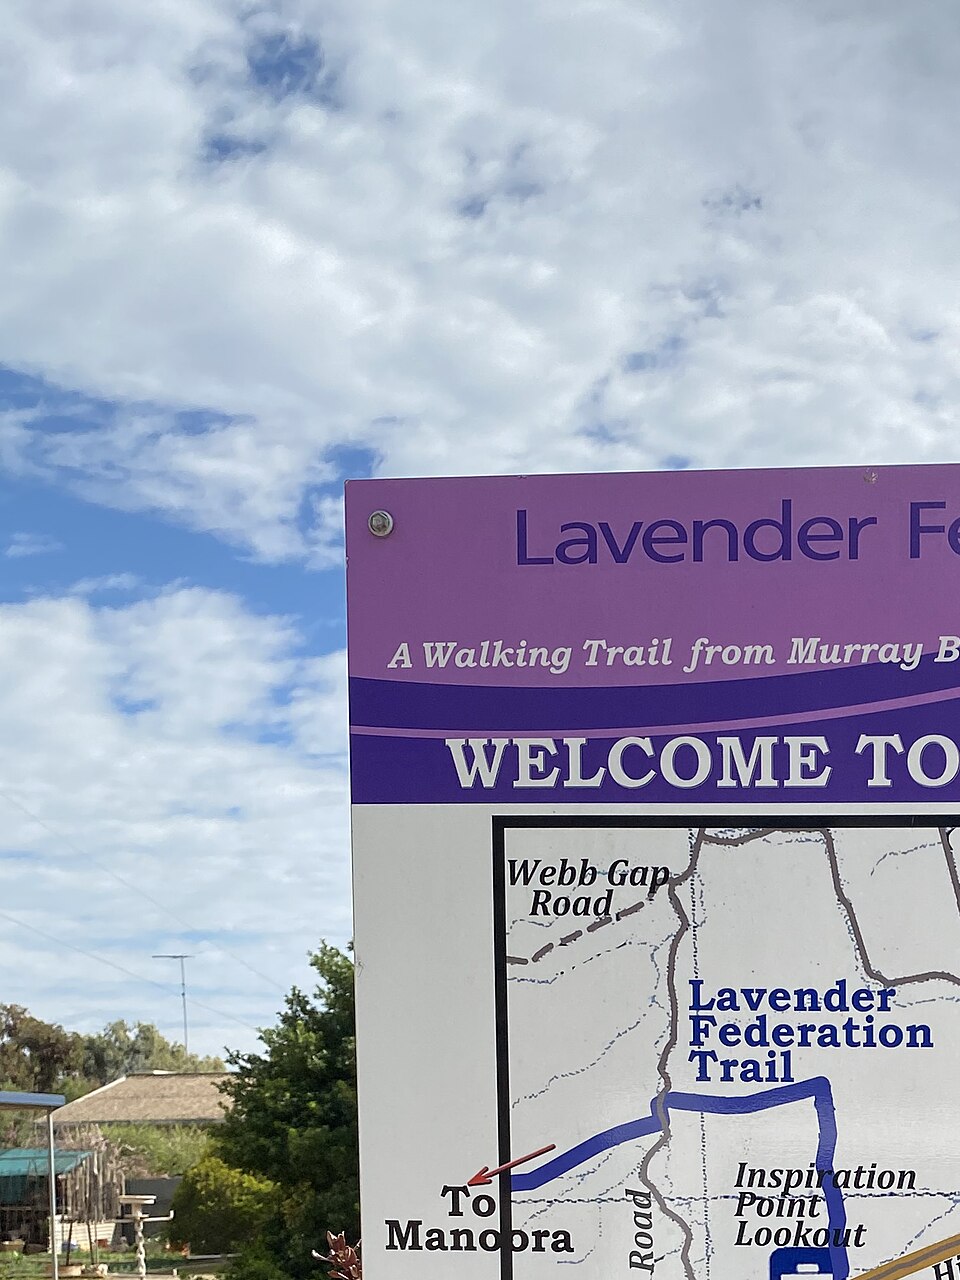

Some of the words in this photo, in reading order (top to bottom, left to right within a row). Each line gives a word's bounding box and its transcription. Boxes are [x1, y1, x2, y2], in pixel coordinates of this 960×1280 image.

[516, 499, 877, 565] Lavender
[388, 643, 412, 668] A
[423, 640, 572, 674] Walking
[582, 638, 672, 666] Trail
[683, 637, 776, 672] from
[788, 637, 922, 671] Murray
[445, 734, 832, 789] WELCOME
[854, 732, 960, 788] TO
[507, 860, 598, 887] Webb
[607, 860, 670, 895] Gap
[529, 889, 612, 917] Road
[689, 979, 896, 1013] Lavender
[689, 1015, 933, 1048] Federation
[689, 1050, 795, 1083] Trail
[734, 1162, 916, 1194] Inspiration
[441, 1185, 496, 1217] To
[734, 1192, 821, 1217] Point
[385, 1220, 574, 1253] Manoora
[625, 1189, 655, 1269] Road
[734, 1220, 867, 1247] Lookout
